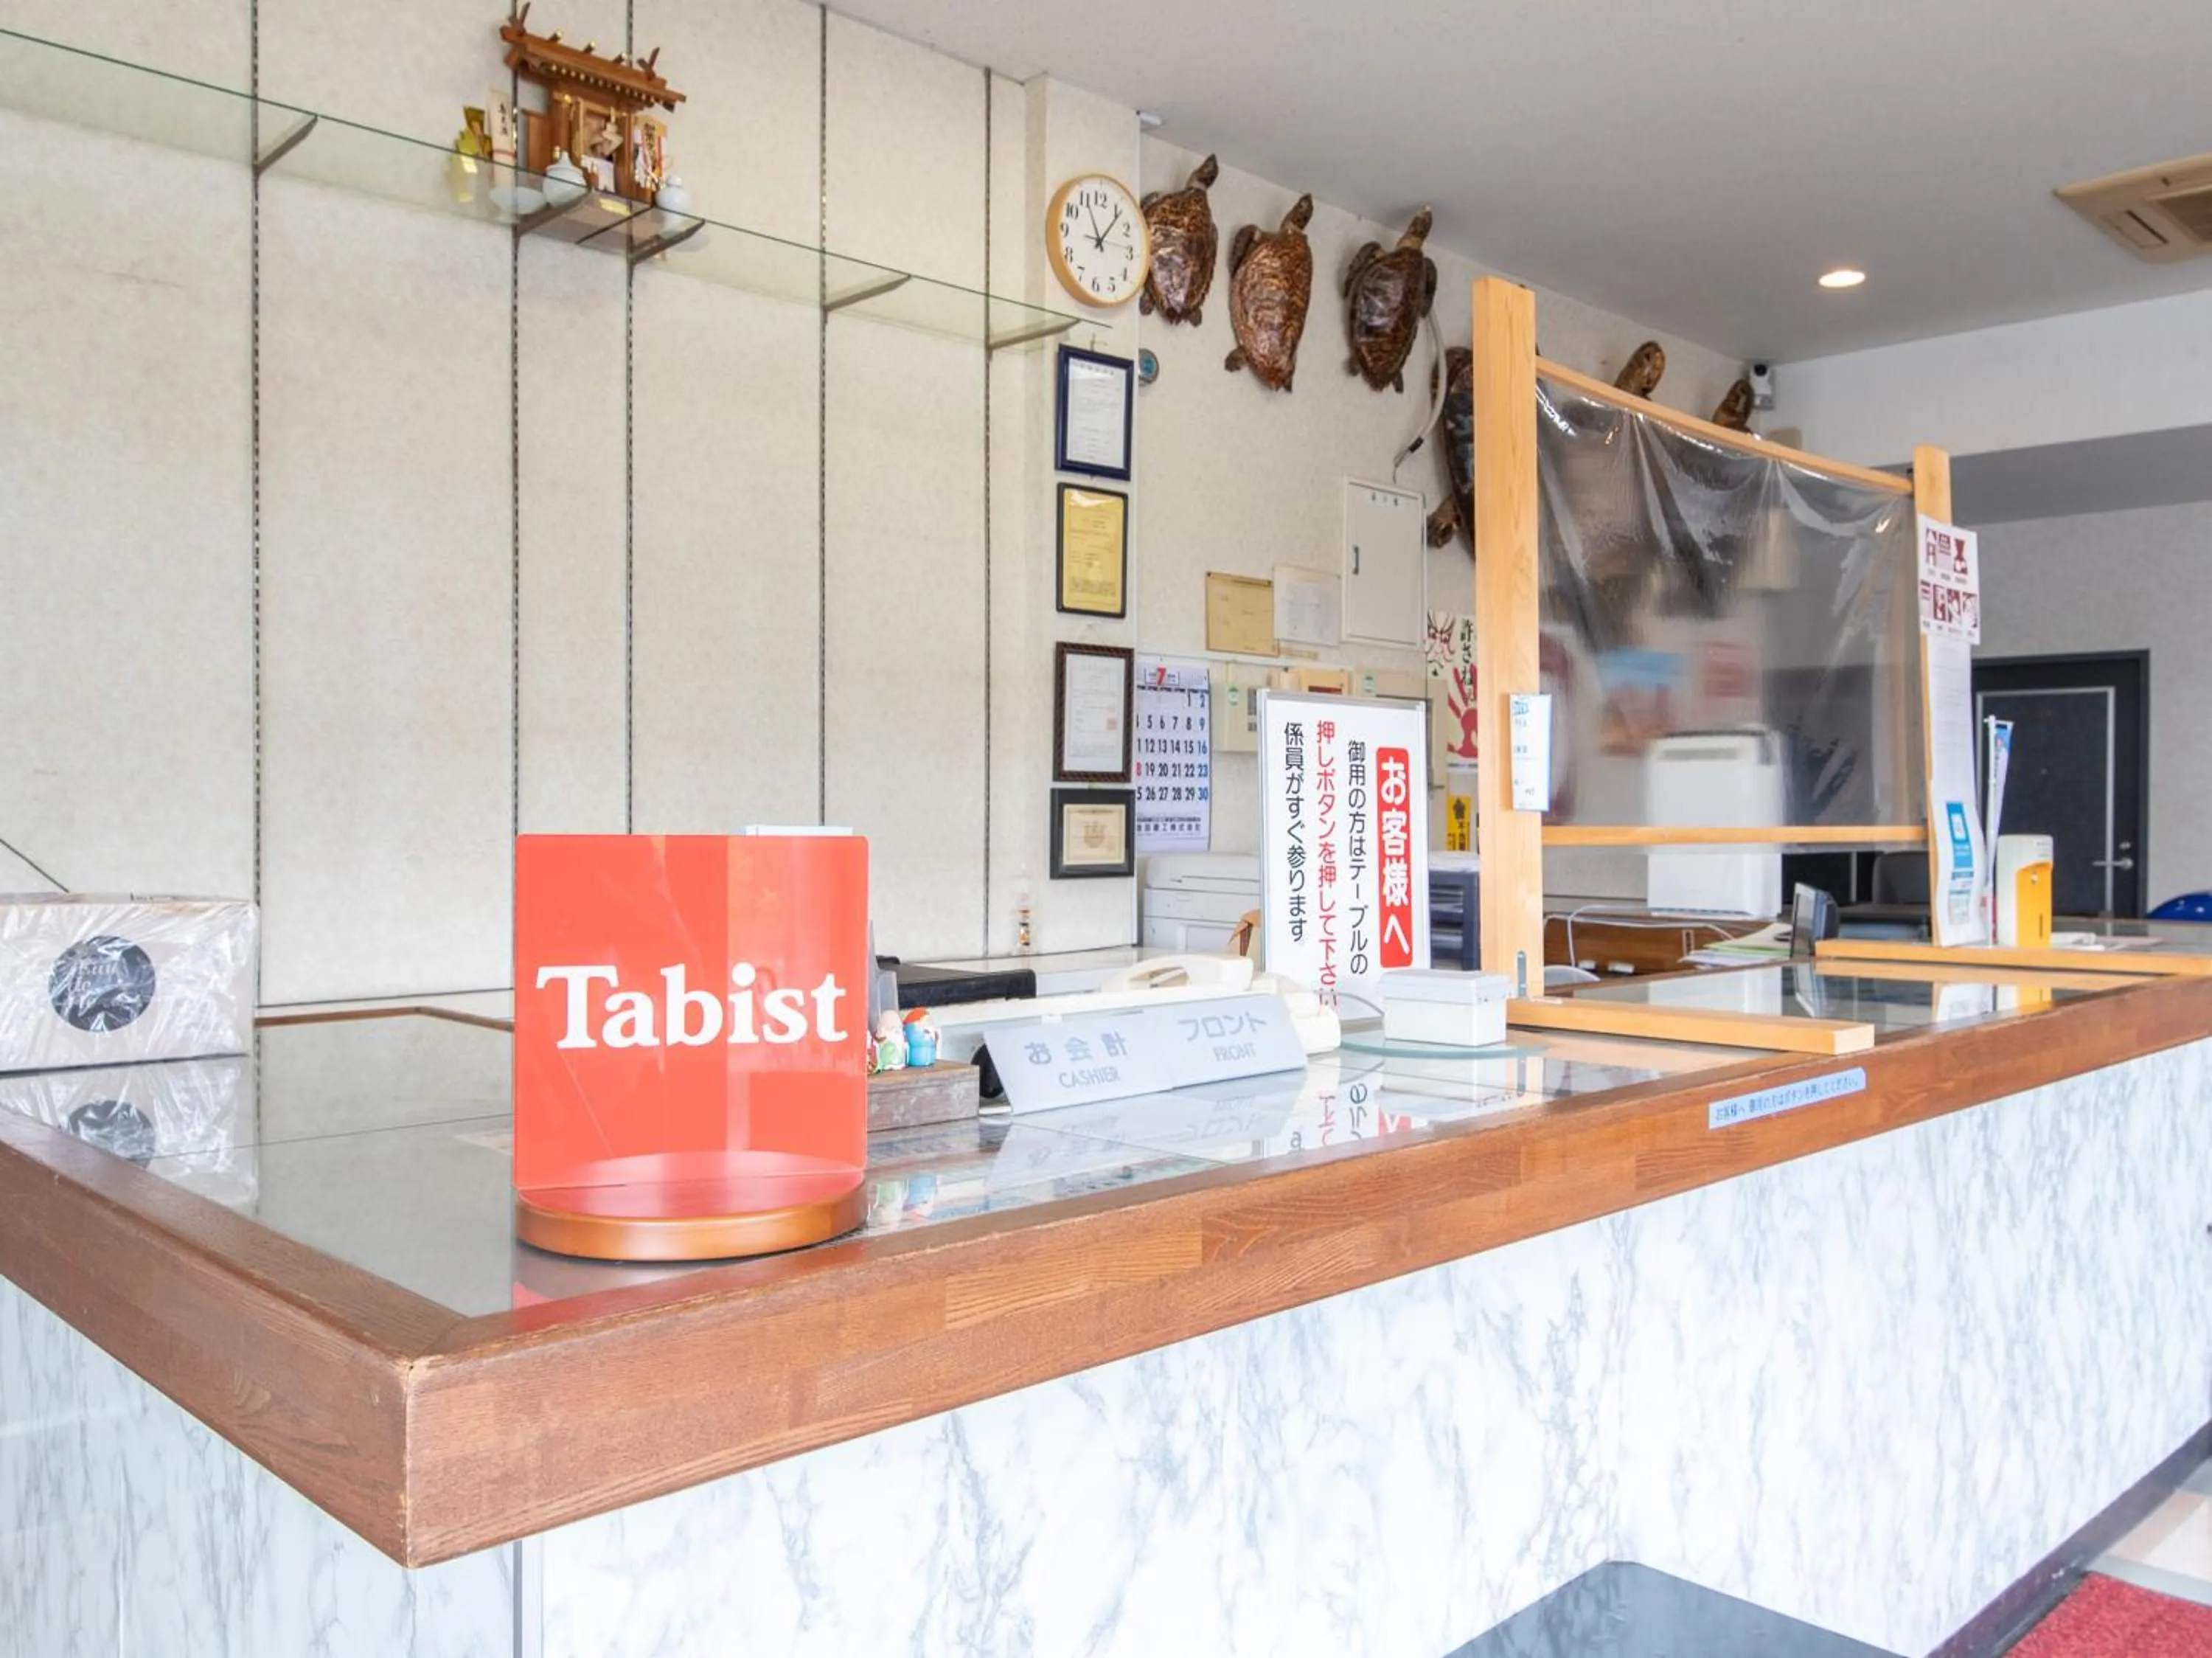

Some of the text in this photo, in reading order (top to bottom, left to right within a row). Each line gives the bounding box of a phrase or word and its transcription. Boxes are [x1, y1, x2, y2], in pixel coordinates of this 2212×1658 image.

[1157, 667, 1166, 685] 7
[1147, 714, 1152, 729] 5
[1160, 715, 1166, 729] 6
[1172, 716, 1178, 730] 7
[1186, 717, 1192, 730] 8
[1200, 717, 1206, 732] 9
[1145, 738, 1155, 754] 12
[1158, 739, 1168, 754] 13
[1171, 739, 1180, 755] 14
[1184, 740, 1194, 755] 15
[1197, 740, 1208, 755] 16
[1145, 762, 1155, 777] 19
[1158, 763, 1169, 777] 20
[1172, 763, 1181, 777] 21
[1185, 763, 1195, 778] 22
[1198, 763, 1208, 778] 23
[1146, 786, 1156, 801] 26
[1159, 786, 1169, 801] 27
[1172, 786, 1182, 801] 28
[1185, 787, 1195, 801] 29
[1198, 787, 1208, 801] 30
[1284, 721, 1307, 943] 係員がすぐ参ります
[1347, 740, 1368, 976] 御用の方はテーブルの
[1380, 755, 1411, 956] お客様へ
[536, 962, 849, 1049] Tabist
[1178, 1010, 1267, 1042] フロント
[1023, 1031, 1128, 1065] お会計
[1212, 1042, 1256, 1062] FRONT
[1059, 1066, 1121, 1089] CASHIER
